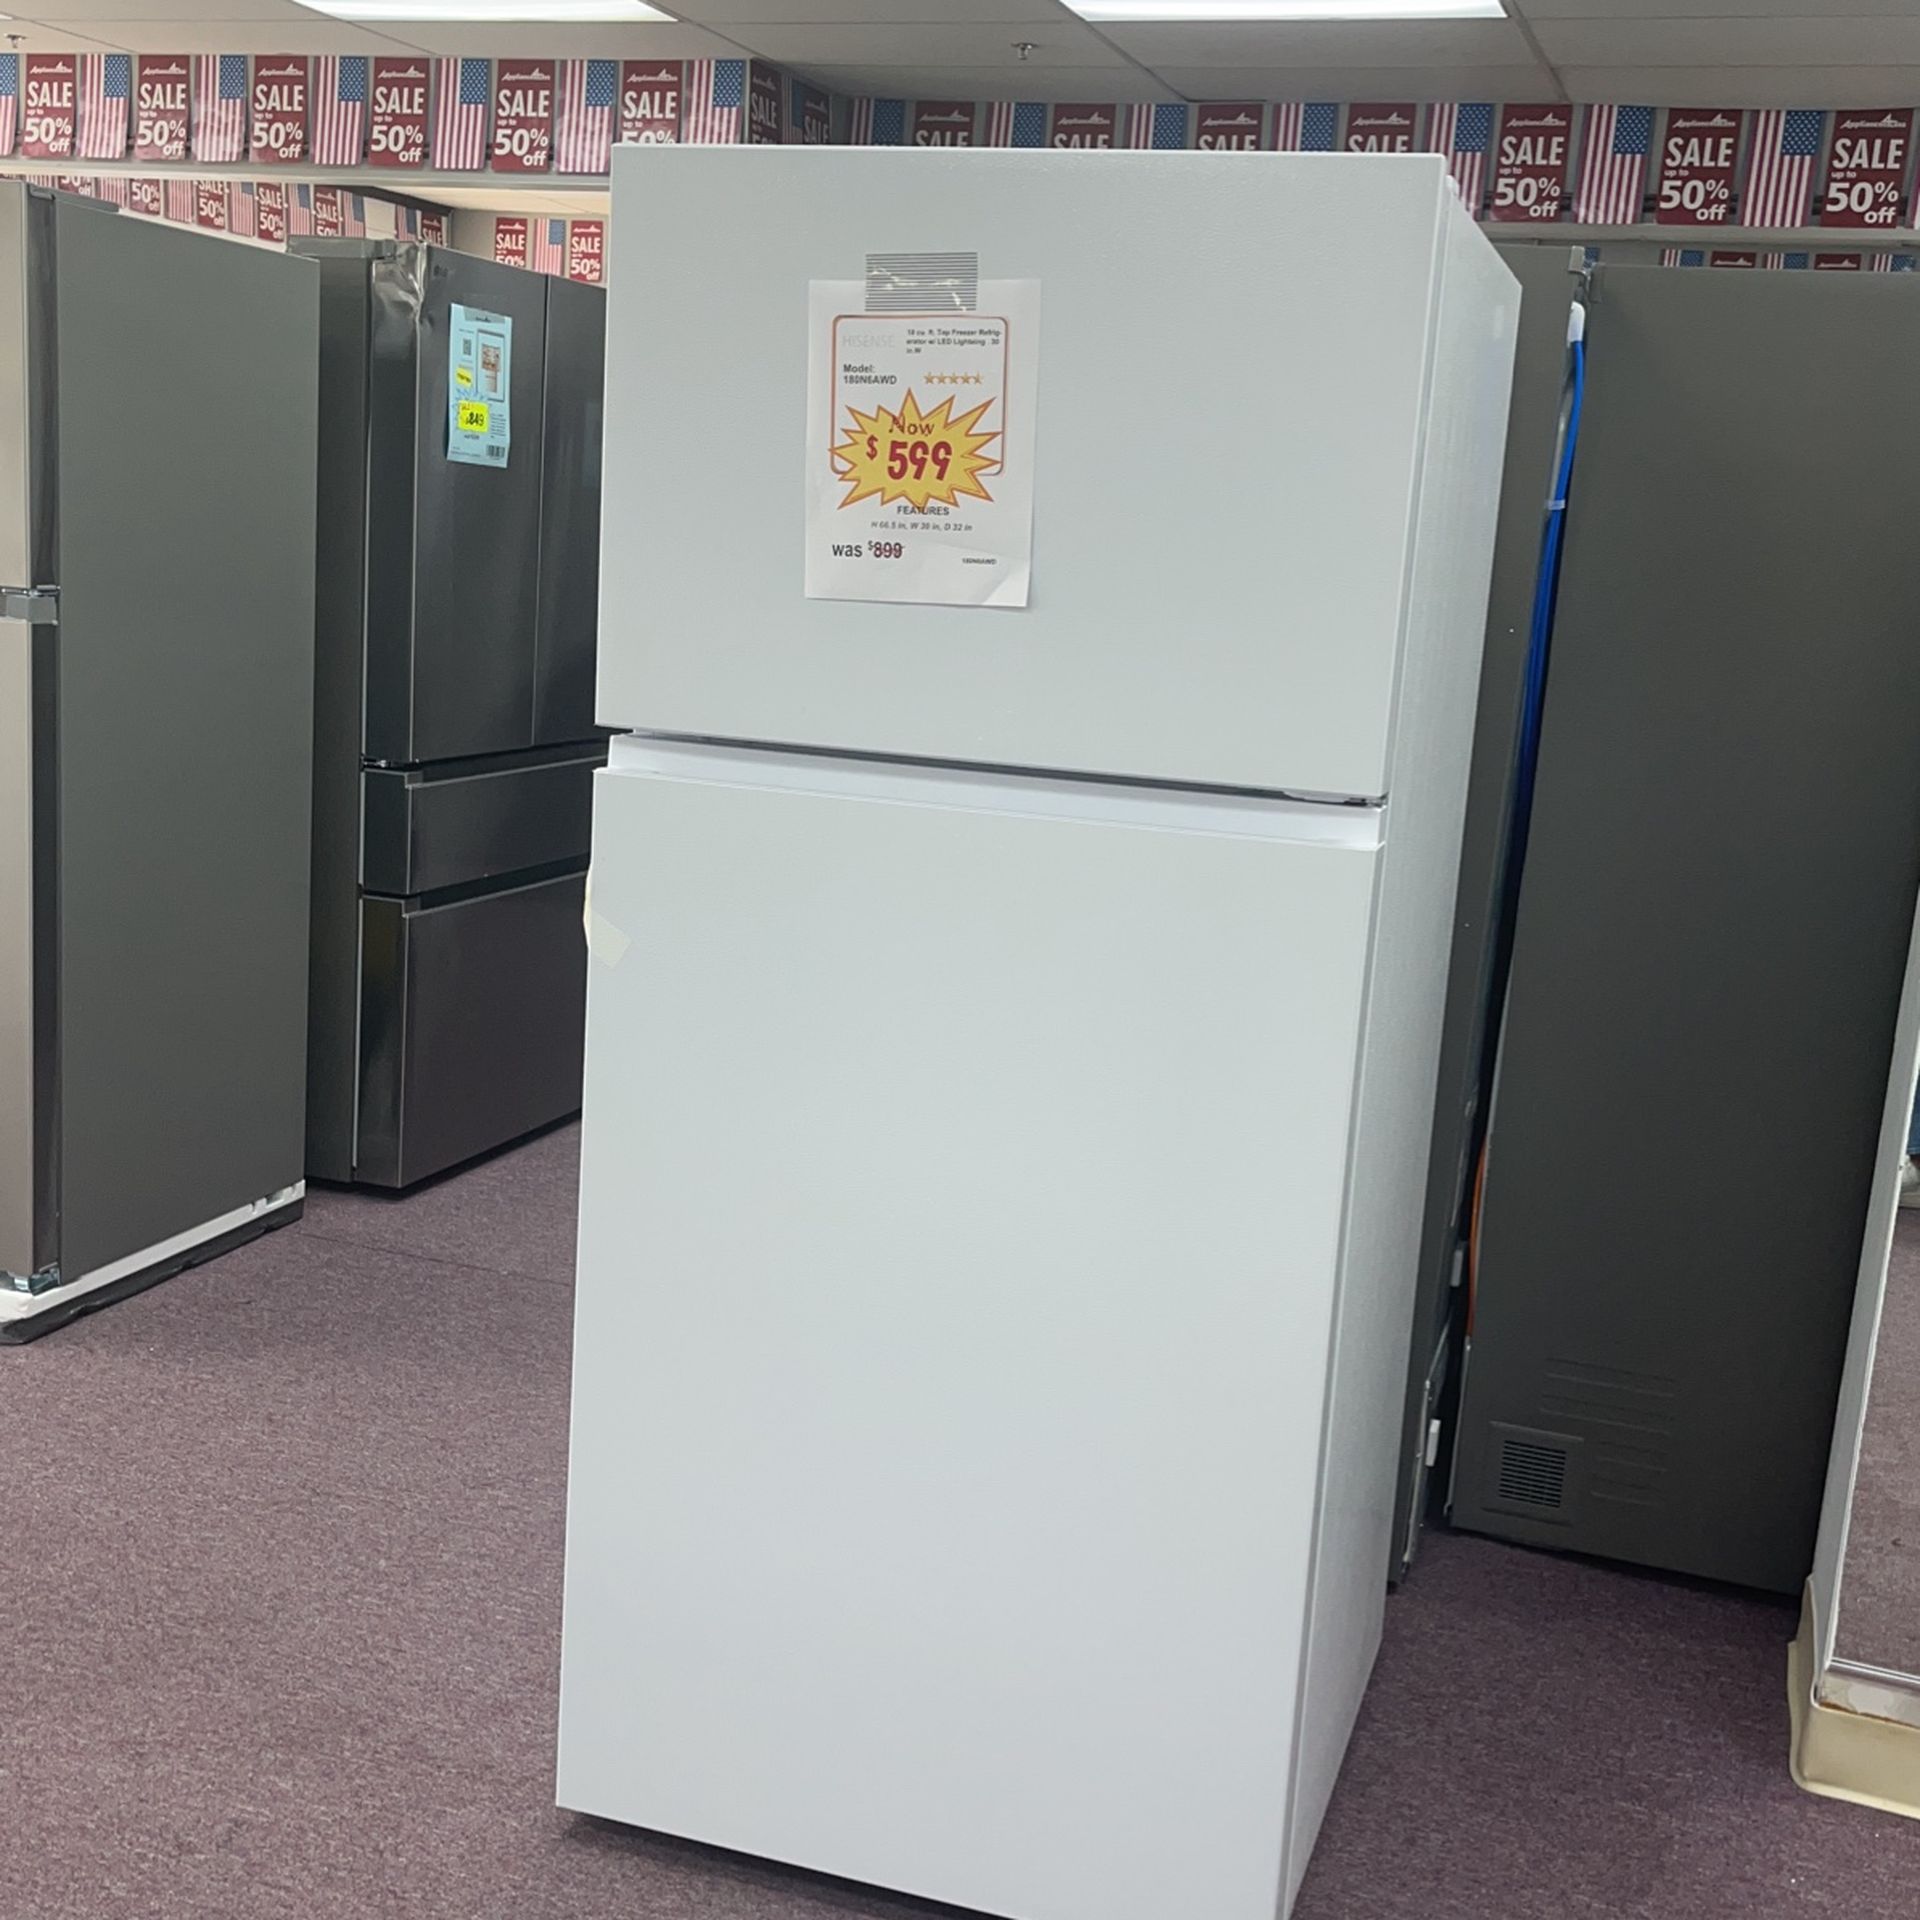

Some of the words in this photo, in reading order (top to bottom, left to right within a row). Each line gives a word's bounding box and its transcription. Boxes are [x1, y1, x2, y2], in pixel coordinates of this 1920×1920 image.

[27, 81, 73, 107] SALE
[139, 83, 186, 110] SALE
[254, 84, 305, 112] SALE
[374, 86, 425, 115] SALE
[497, 89, 550, 118] SALE
[623, 90, 677, 120] SALE
[751, 91, 777, 129] SALE
[24, 117, 73, 144] 50%
[137, 119, 187, 147] 50%
[252, 121, 304, 150] 50%
[370, 124, 424, 153] 50%
[49, 137, 71, 154] off
[163, 140, 184, 157] off
[279, 143, 302, 159] off
[494, 128, 549, 157] 50%
[1500, 135, 1565, 167] SALE
[1665, 137, 1734, 168] SALE
[1831, 137, 1905, 170] SALE
[398, 147, 422, 163] off
[523, 150, 547, 167] off
[1499, 168, 1511, 176] up
[1513, 167, 1523, 175] to
[1664, 169, 1677, 178] up
[1679, 168, 1689, 176] to
[1831, 171, 1844, 180] up
[1846, 170, 1857, 179] to
[258, 187, 282, 209] SALE
[1495, 177, 1561, 207] 50%
[1659, 179, 1729, 210] 50%
[1825, 181, 1899, 213] 50%
[315, 202, 338, 222] SALE
[1529, 201, 1558, 218] off
[1696, 204, 1726, 221] off
[1863, 206, 1897, 224] off
[496, 233, 526, 251] SALE
[571, 236, 601, 253] SALE
[937, 328, 951, 337] Top
[952, 328, 977, 336] Freezer
[843, 364, 876, 373] Model:
[888, 414, 935, 437] Now
[896, 505, 950, 516] FEATURES
[832, 544, 863, 558] was
